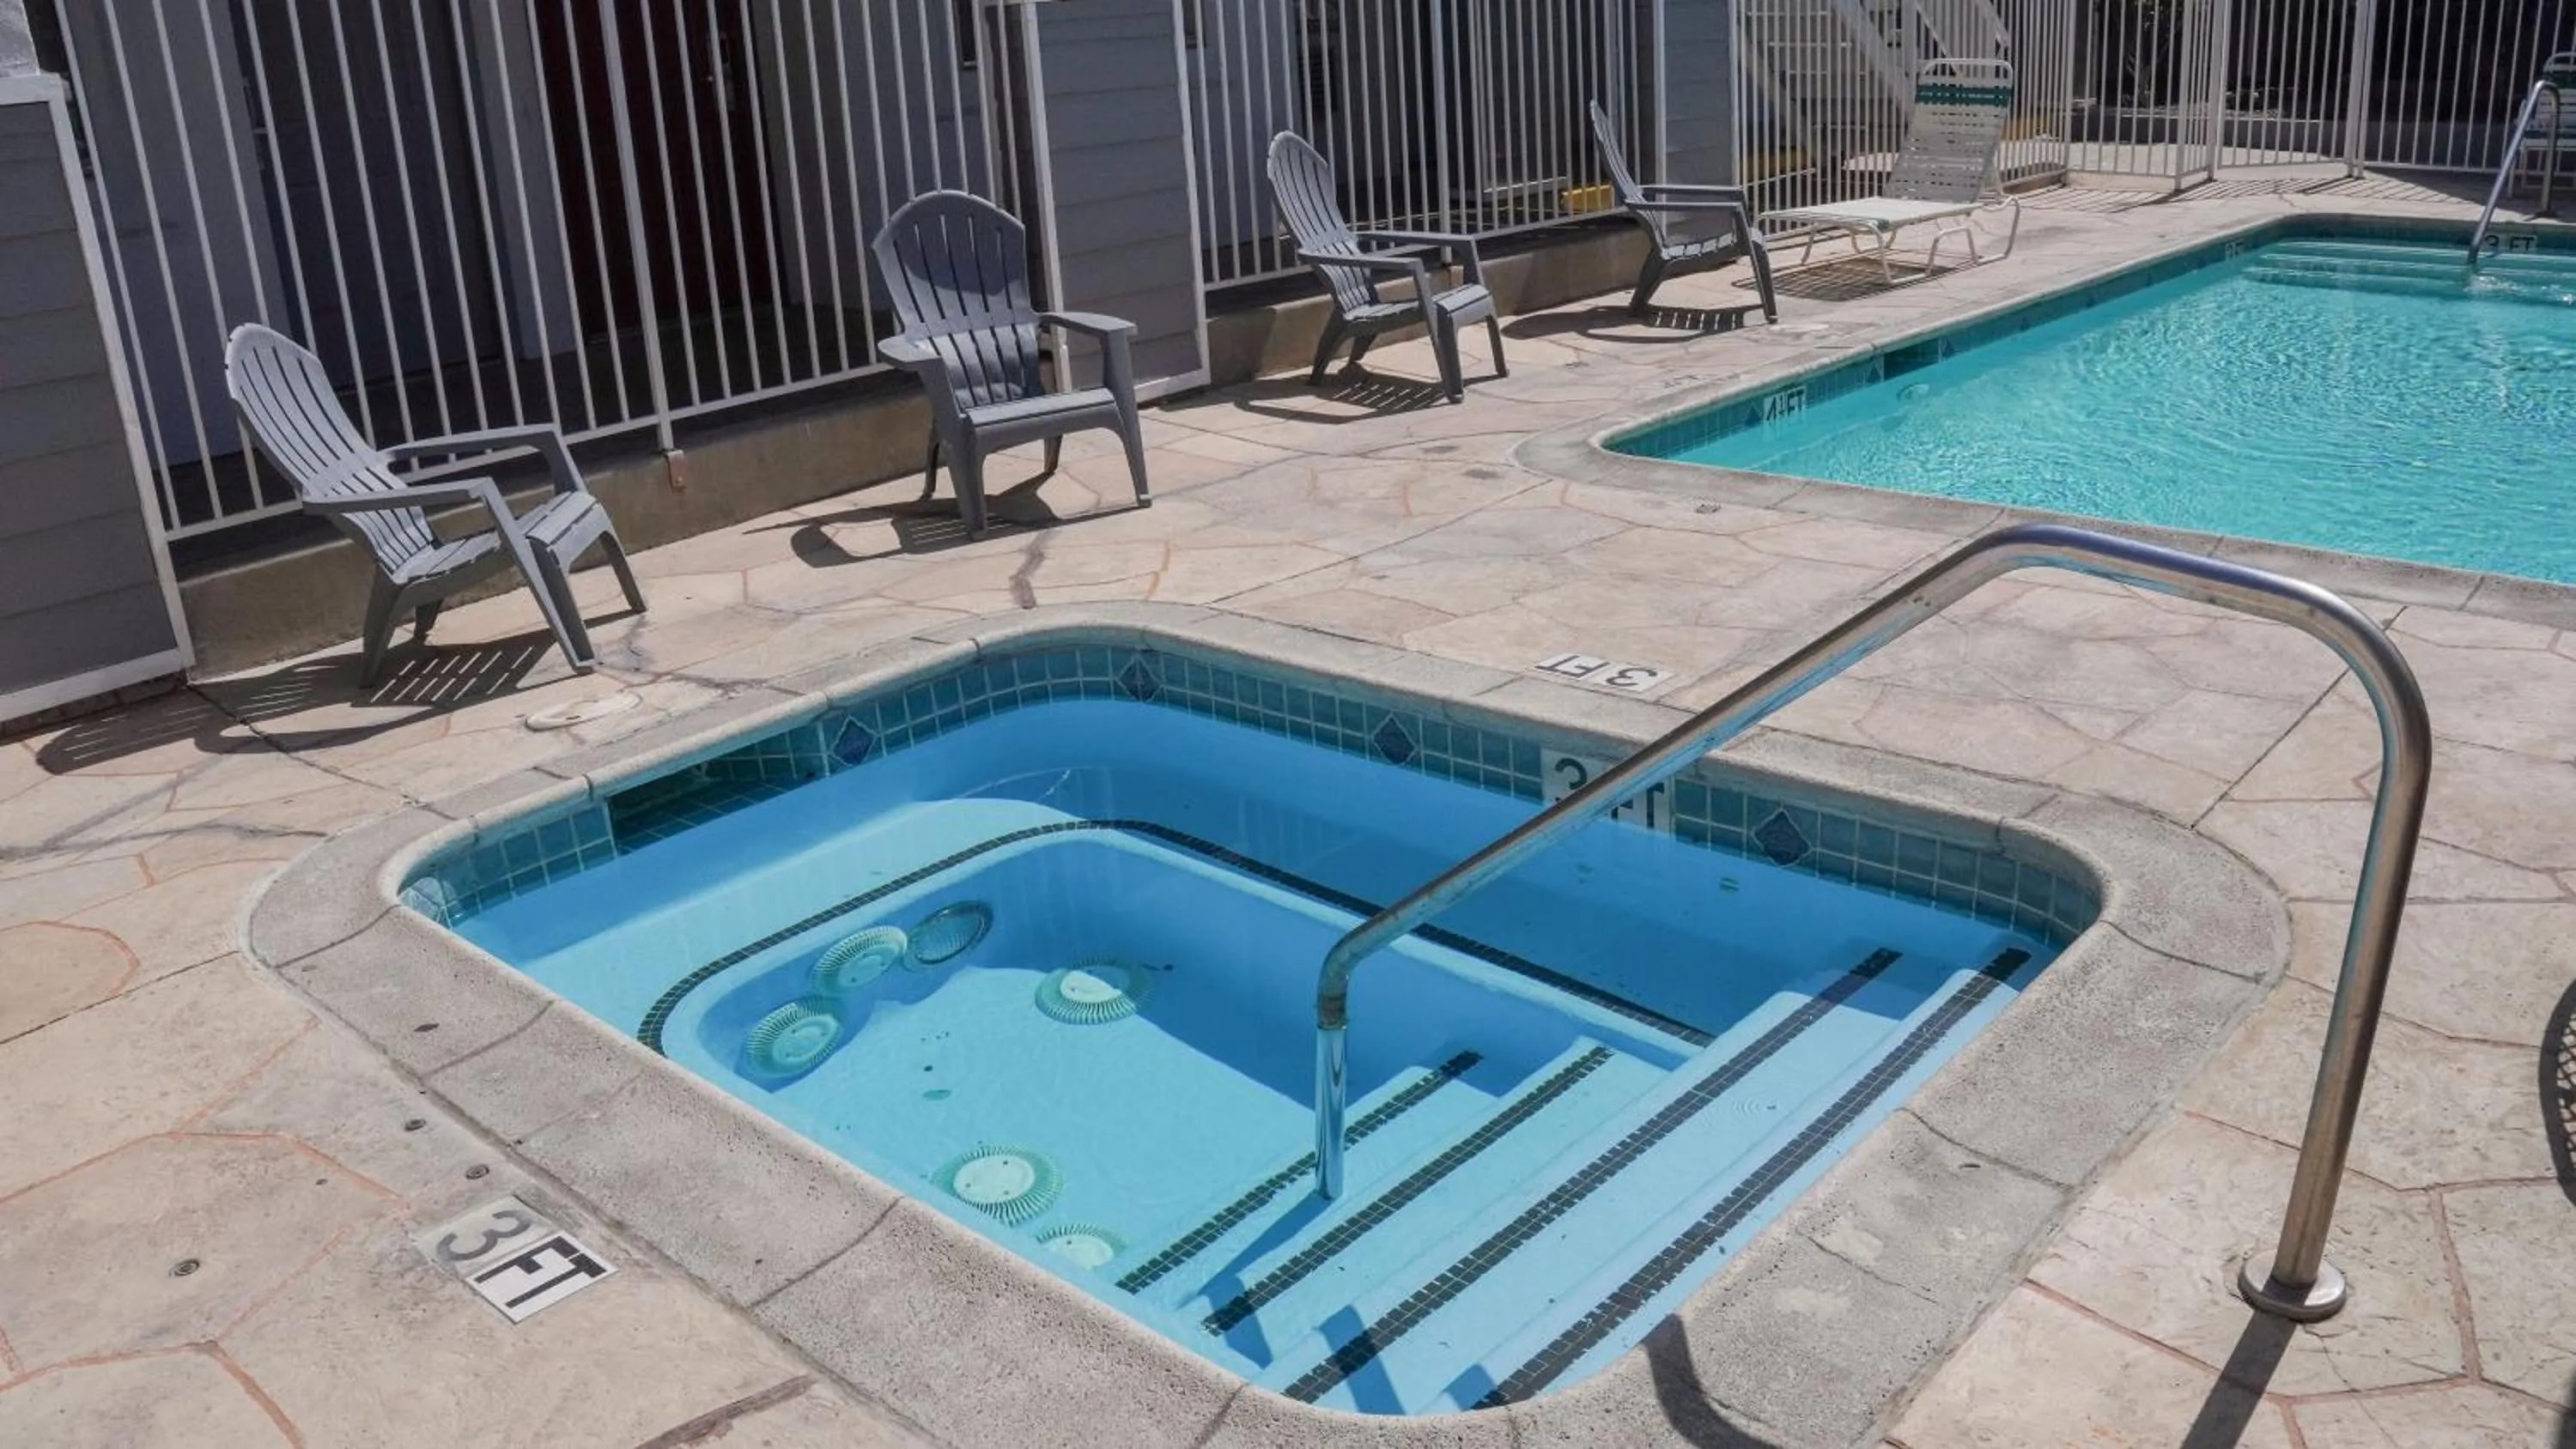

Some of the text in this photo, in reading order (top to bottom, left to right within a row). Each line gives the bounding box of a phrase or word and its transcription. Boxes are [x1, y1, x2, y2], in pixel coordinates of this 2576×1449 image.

[1534, 655, 1658, 687] 3 FT
[436, 1209, 608, 1309] 3 FT
